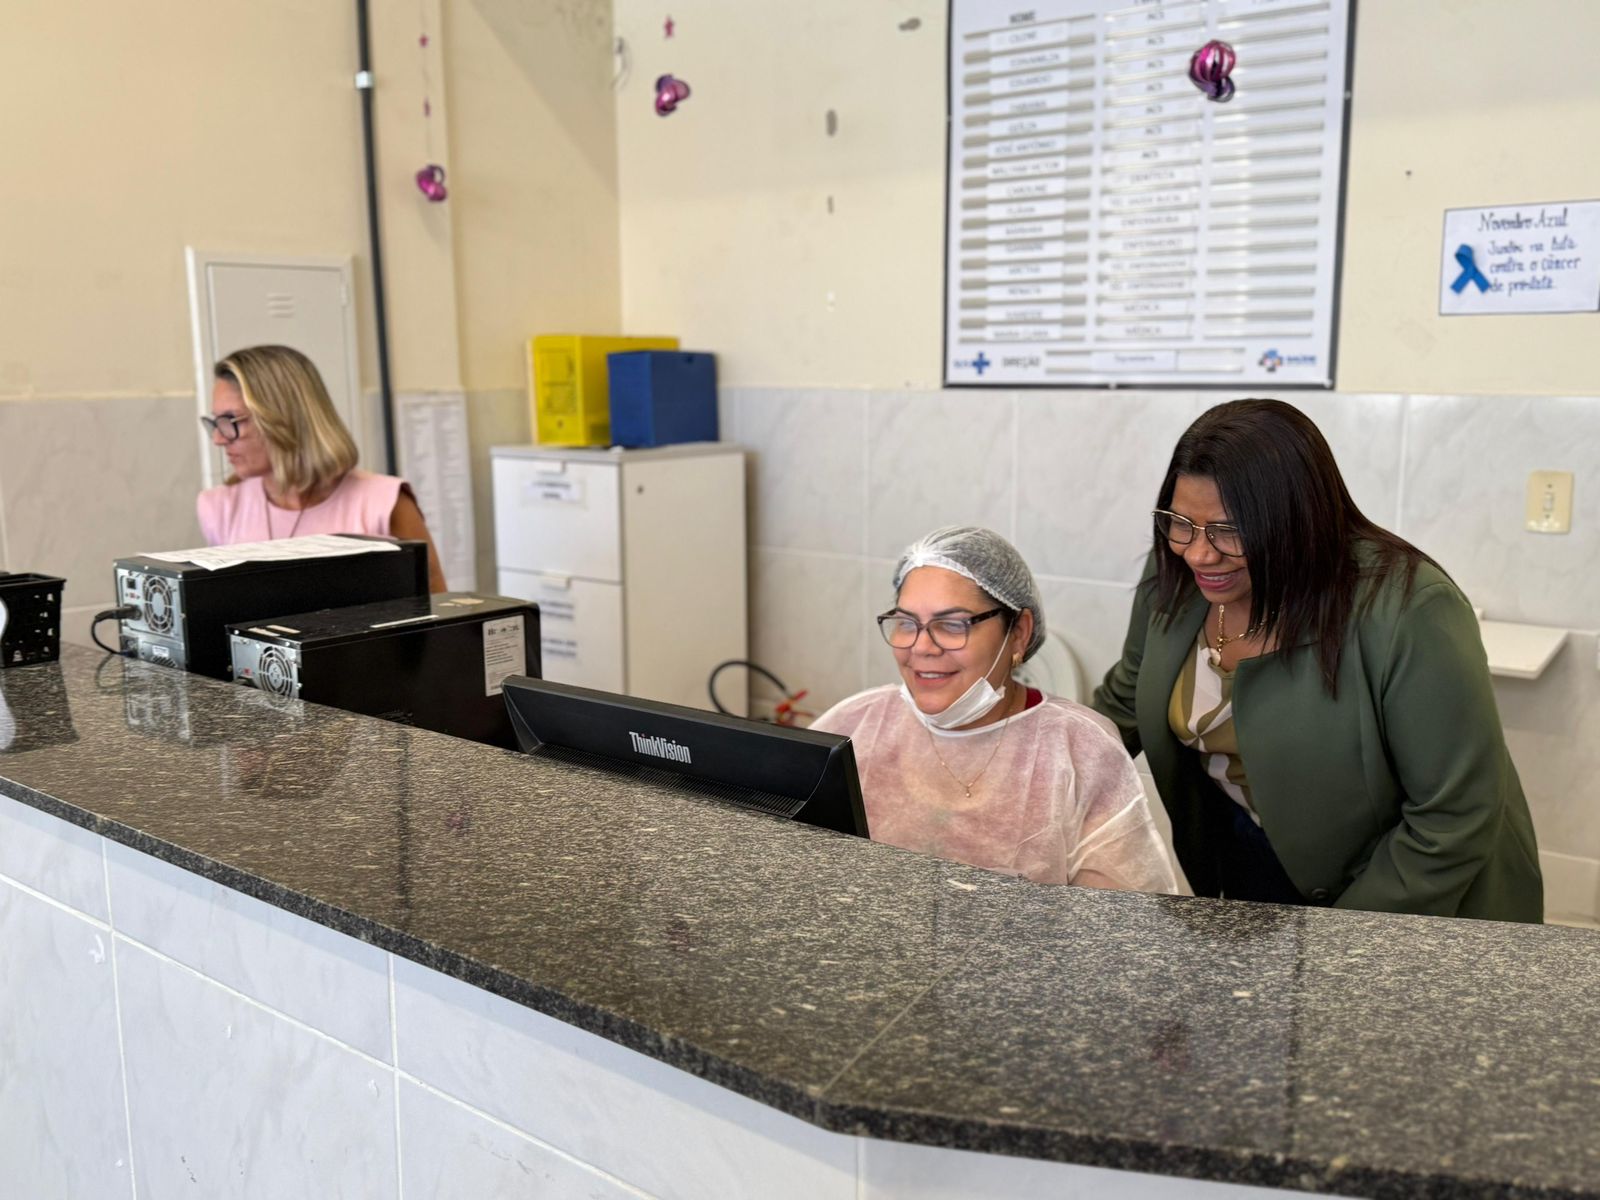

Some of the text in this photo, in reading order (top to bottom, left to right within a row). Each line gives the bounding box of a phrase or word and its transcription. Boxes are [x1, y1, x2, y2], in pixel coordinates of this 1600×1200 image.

[1478, 207, 1569, 232] Novembro Azul
[1489, 256, 1524, 274] contra
[1530, 261, 1538, 272] o
[628, 731, 692, 764] ThinkVision
